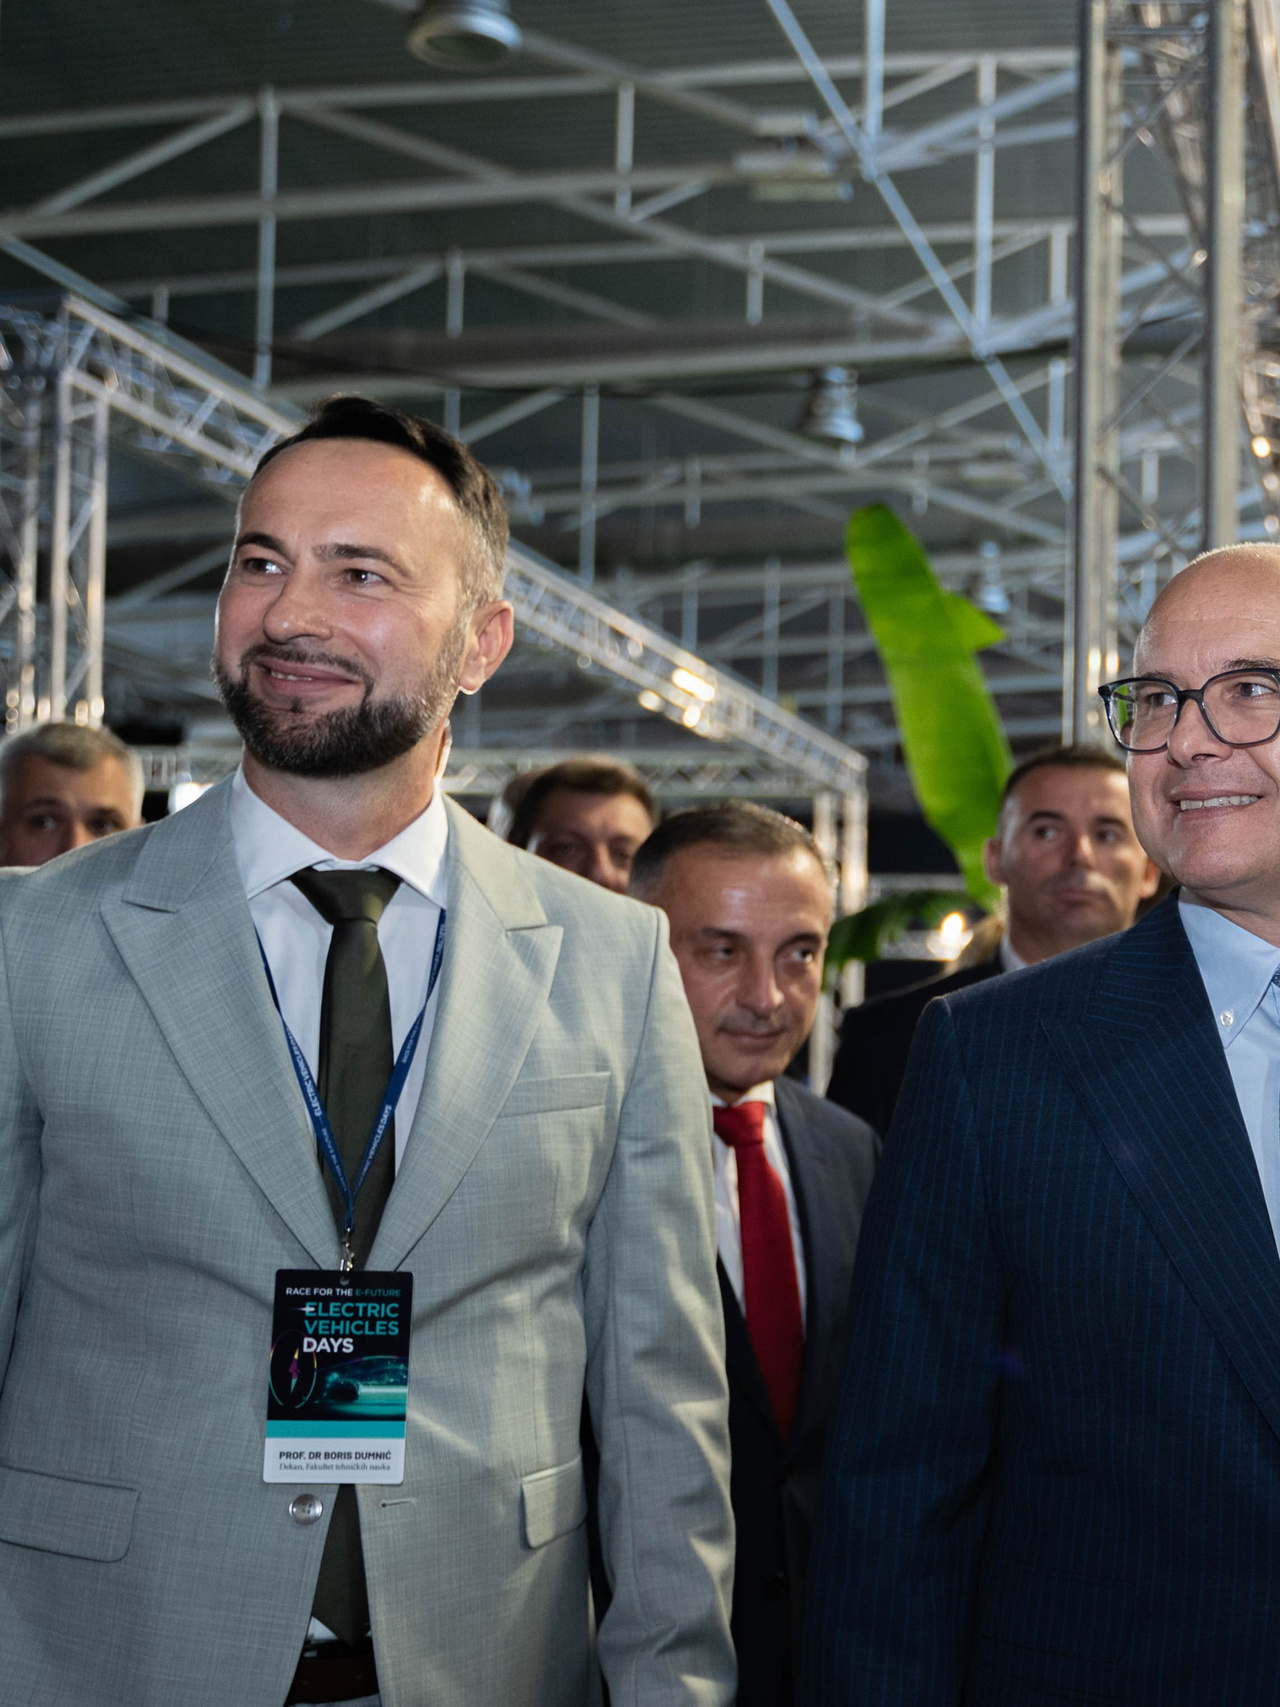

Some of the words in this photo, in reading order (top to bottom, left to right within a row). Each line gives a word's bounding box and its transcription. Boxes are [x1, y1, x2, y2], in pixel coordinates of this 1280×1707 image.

[294, 1046, 309, 1080] VEHICLES
[304, 1079, 322, 1117] ELECTRIC
[368, 1124, 384, 1159] VEHICLES
[380, 1104, 392, 1125] DAYS
[285, 1287, 311, 1296] RACE
[313, 1287, 333, 1296] FOR
[336, 1288, 353, 1297] THE
[355, 1288, 402, 1297] E-FUTURE
[304, 1301, 399, 1318] ELECTRIC
[304, 1319, 399, 1336] VEHICLES
[302, 1336, 354, 1353] DAYS
[279, 1451, 306, 1460] PROF.
[308, 1451, 322, 1460] DR
[324, 1451, 353, 1460] BORIS
[355, 1450, 392, 1460] DUMNIĆ
